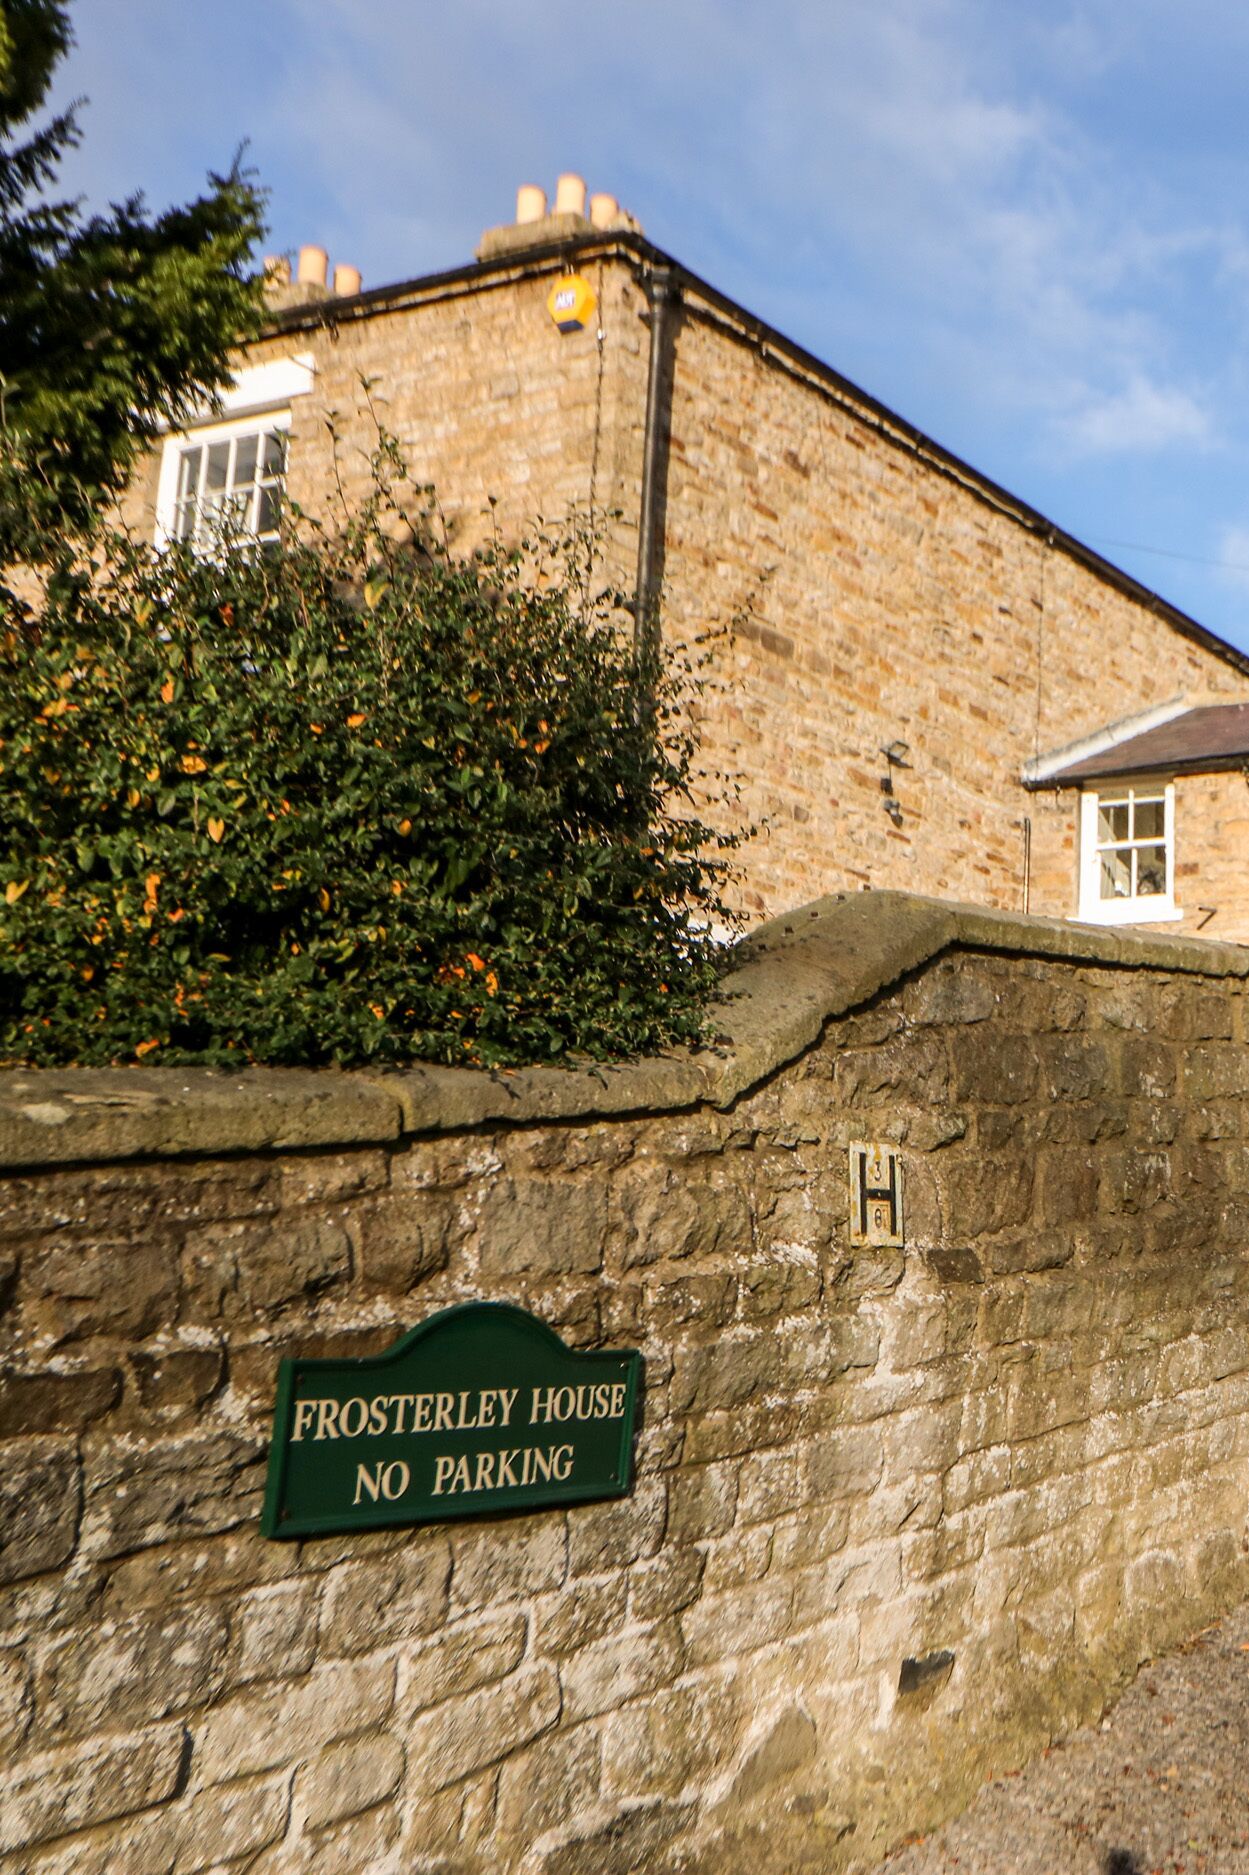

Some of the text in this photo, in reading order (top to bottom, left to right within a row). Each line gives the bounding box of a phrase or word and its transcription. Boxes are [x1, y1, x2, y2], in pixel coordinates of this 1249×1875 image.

[859, 1152, 896, 1236] H
[290, 1384, 626, 1442] FROSTERLEY HOUSE
[352, 1444, 574, 1505] NO PARKING
